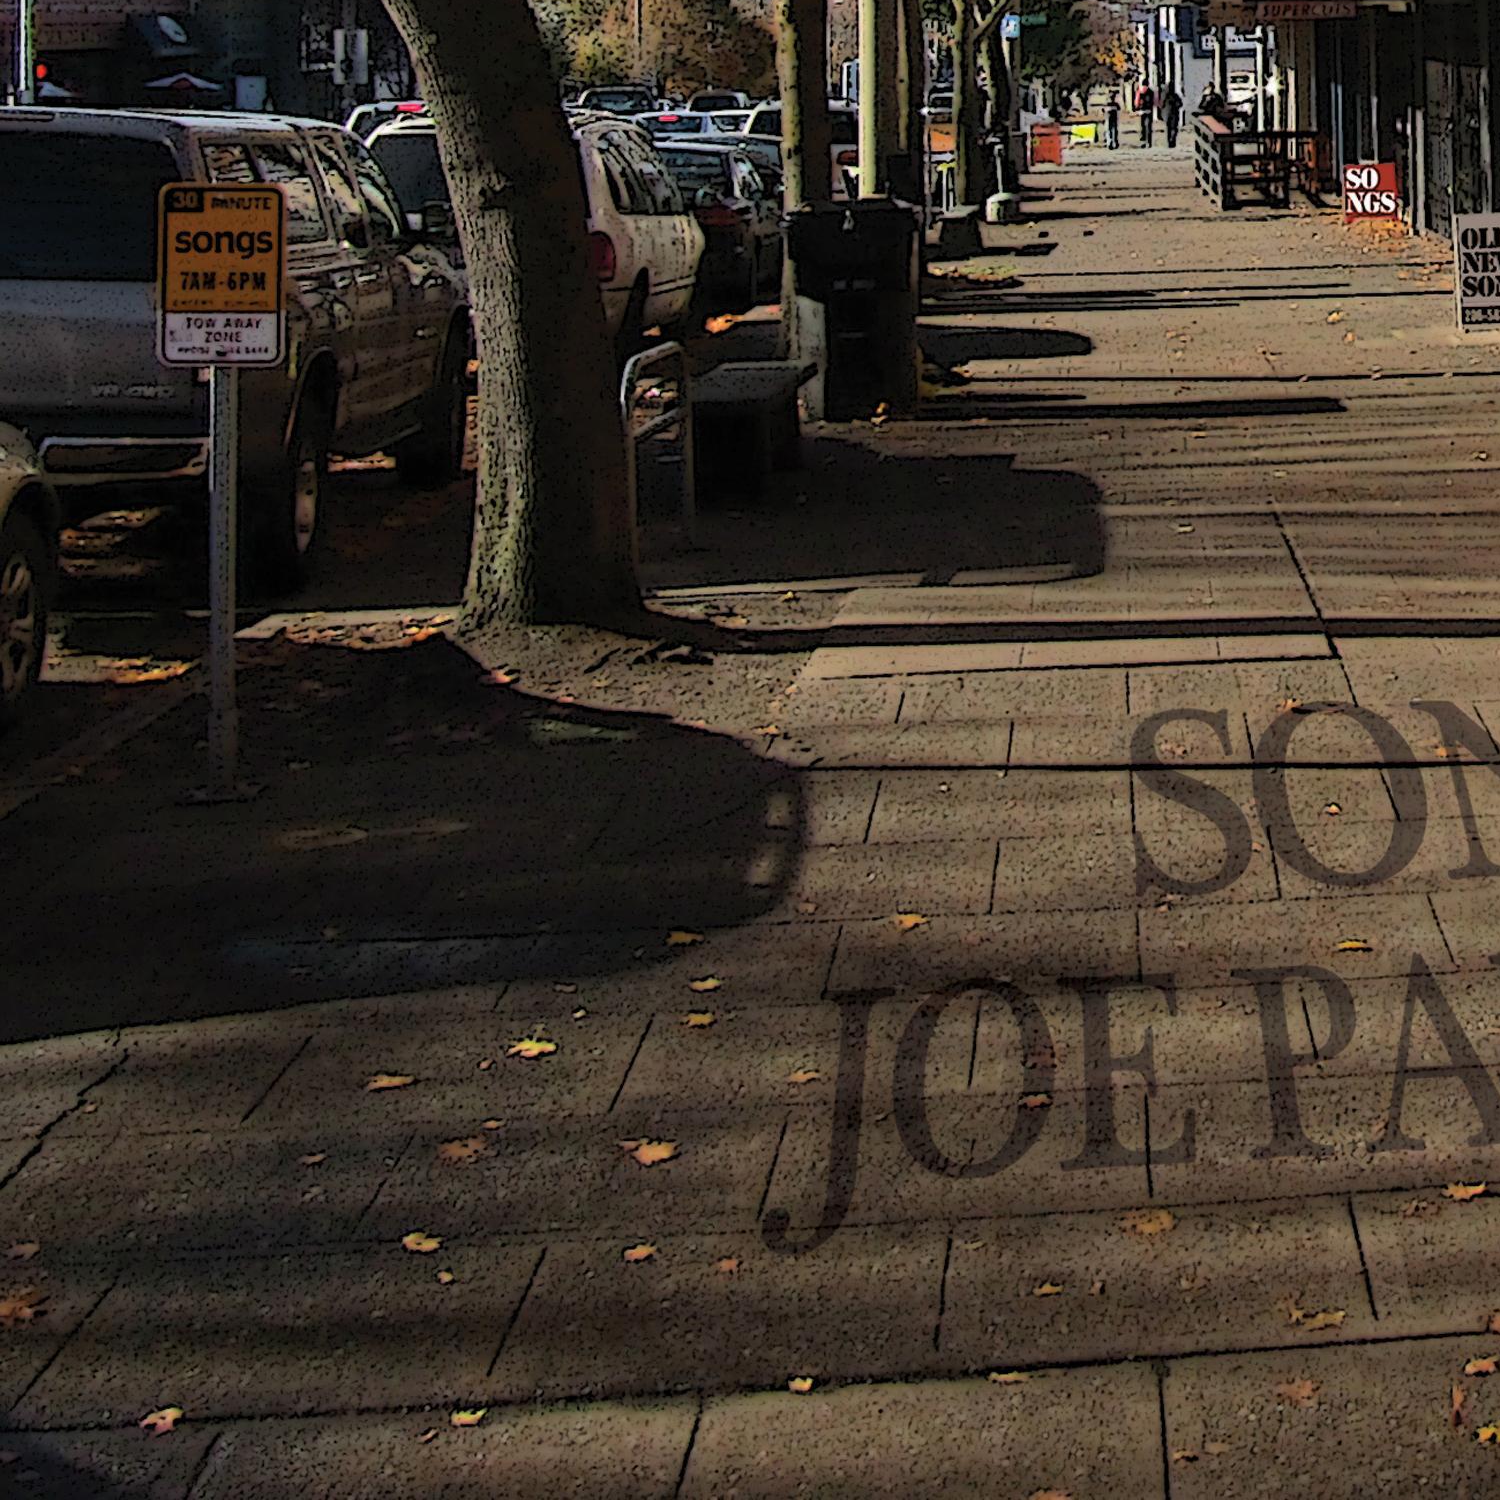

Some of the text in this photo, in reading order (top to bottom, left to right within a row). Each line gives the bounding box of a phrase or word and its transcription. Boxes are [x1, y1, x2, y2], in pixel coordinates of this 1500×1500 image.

[1346, 167, 1379, 190] SO
[173, 191, 198, 209] 30
[1346, 191, 1396, 214] NGS
[175, 231, 273, 260] songs
[186, 317, 217, 330] TOW
[205, 331, 243, 344] ZONE
